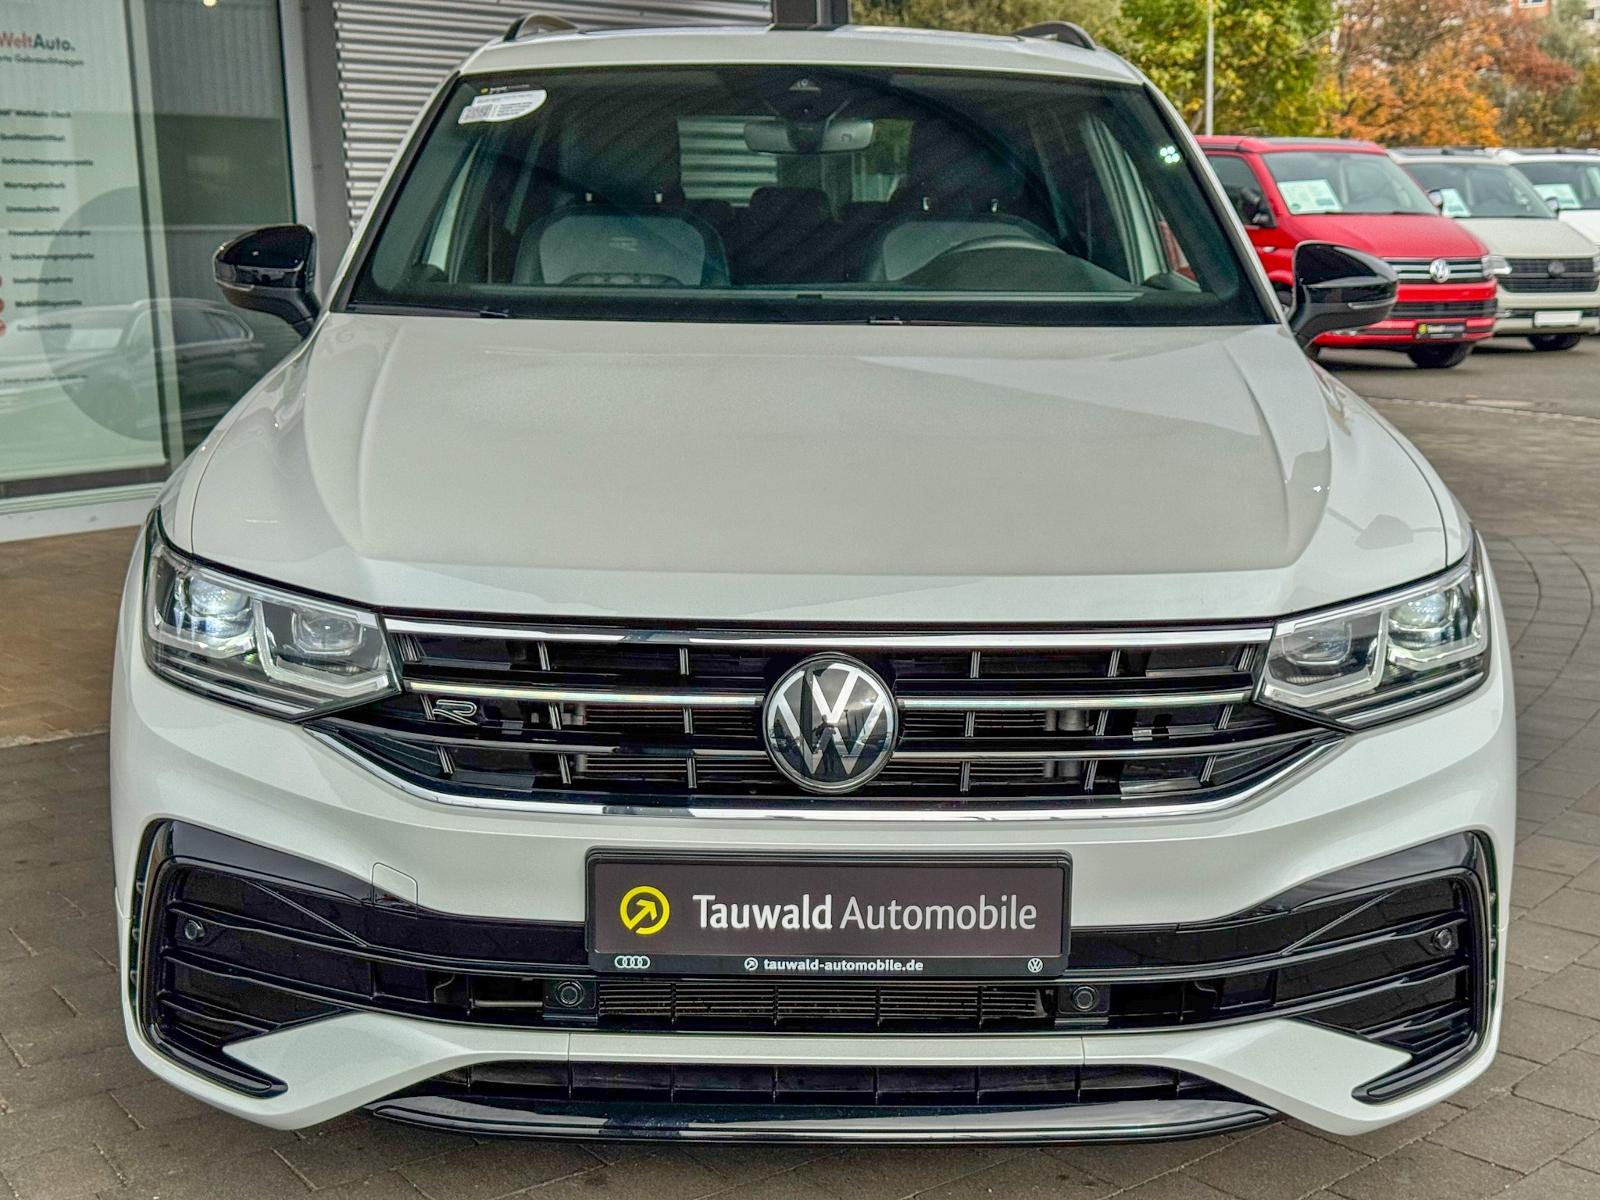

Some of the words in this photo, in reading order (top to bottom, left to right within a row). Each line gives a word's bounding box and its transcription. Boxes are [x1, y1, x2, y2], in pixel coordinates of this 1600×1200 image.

[692, 893, 833, 931] Tauwald
[840, 894, 1037, 931] Automobile
[763, 958, 924, 972] tauwald-automobile.de
